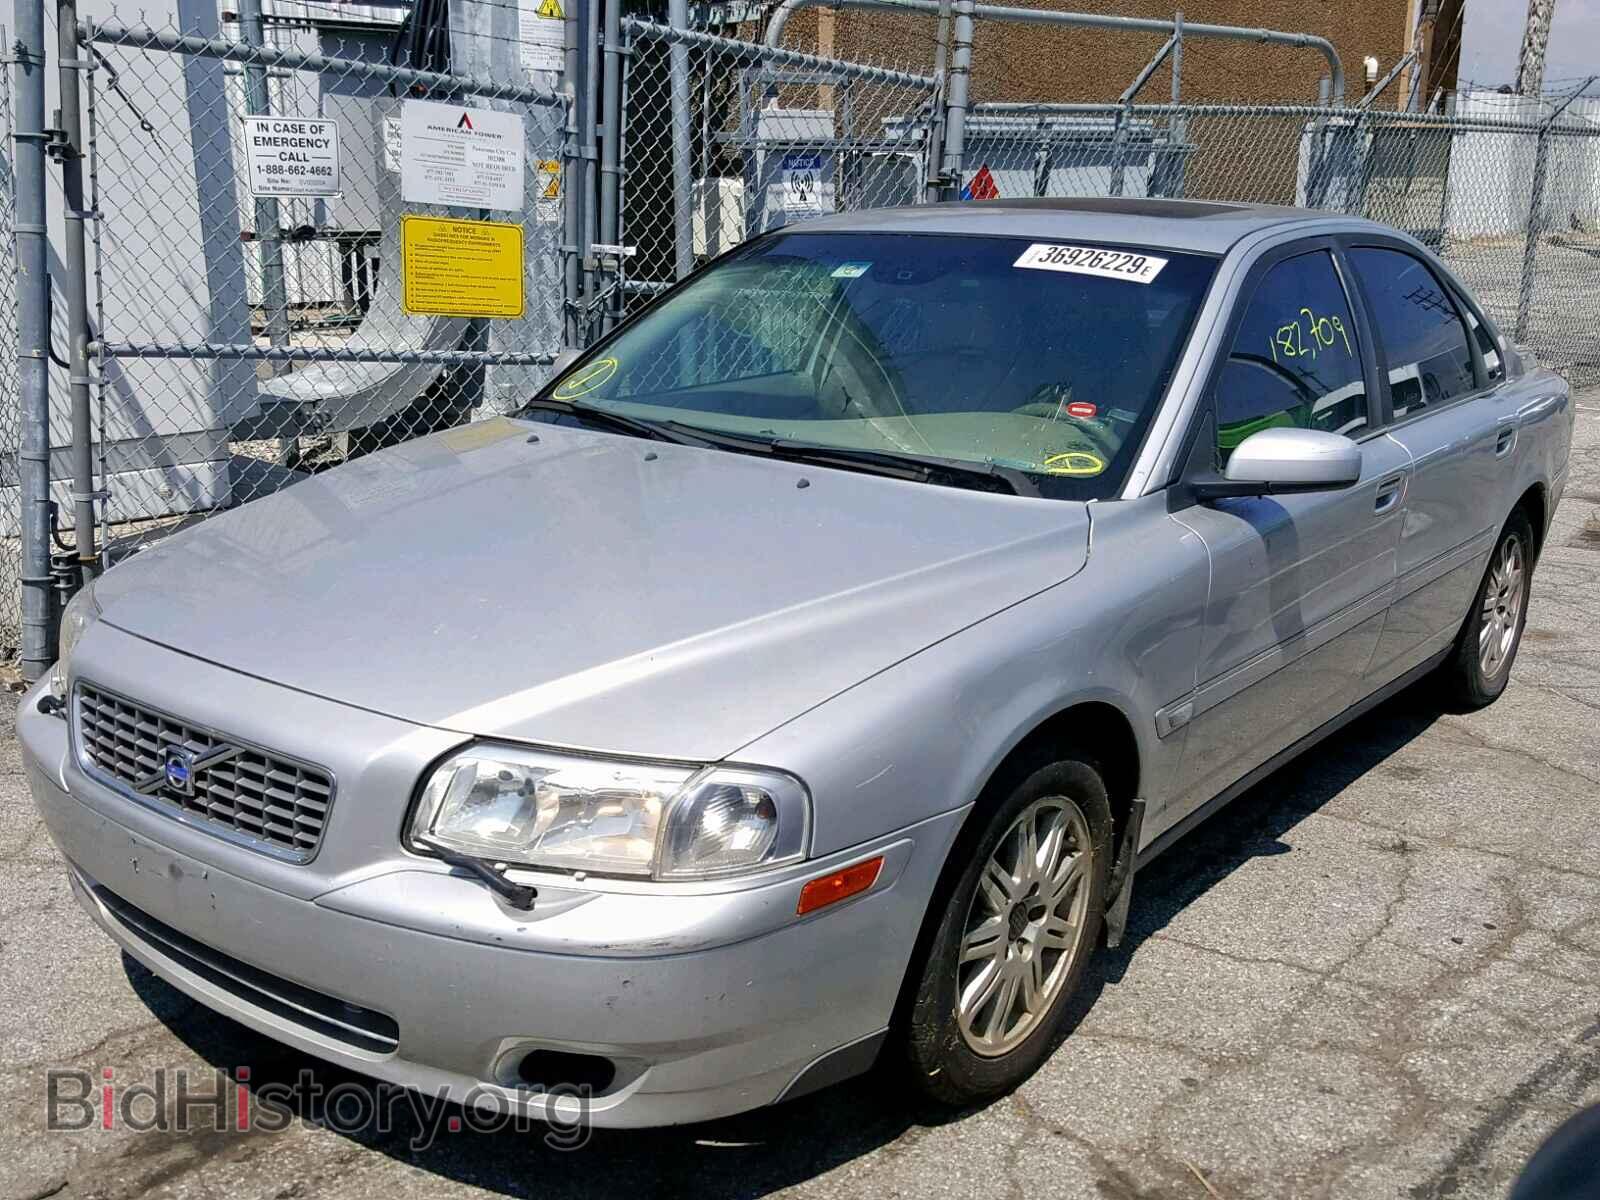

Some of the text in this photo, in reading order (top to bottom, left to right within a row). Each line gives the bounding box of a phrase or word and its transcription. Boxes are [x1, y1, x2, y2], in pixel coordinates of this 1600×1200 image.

[256, 122, 325, 135] IN CASE OF
[427, 125, 472, 135] AMERICAN
[474, 131, 502, 139] TOWER
[253, 136, 330, 149] EMERGENCY
[279, 151, 310, 162] CALL
[256, 164, 332, 176] 1-888-662-4662
[452, 226, 476, 234] NOTICE
[1038, 246, 1147, 274] 36926229
[1269, 308, 1353, 363] 182,709
